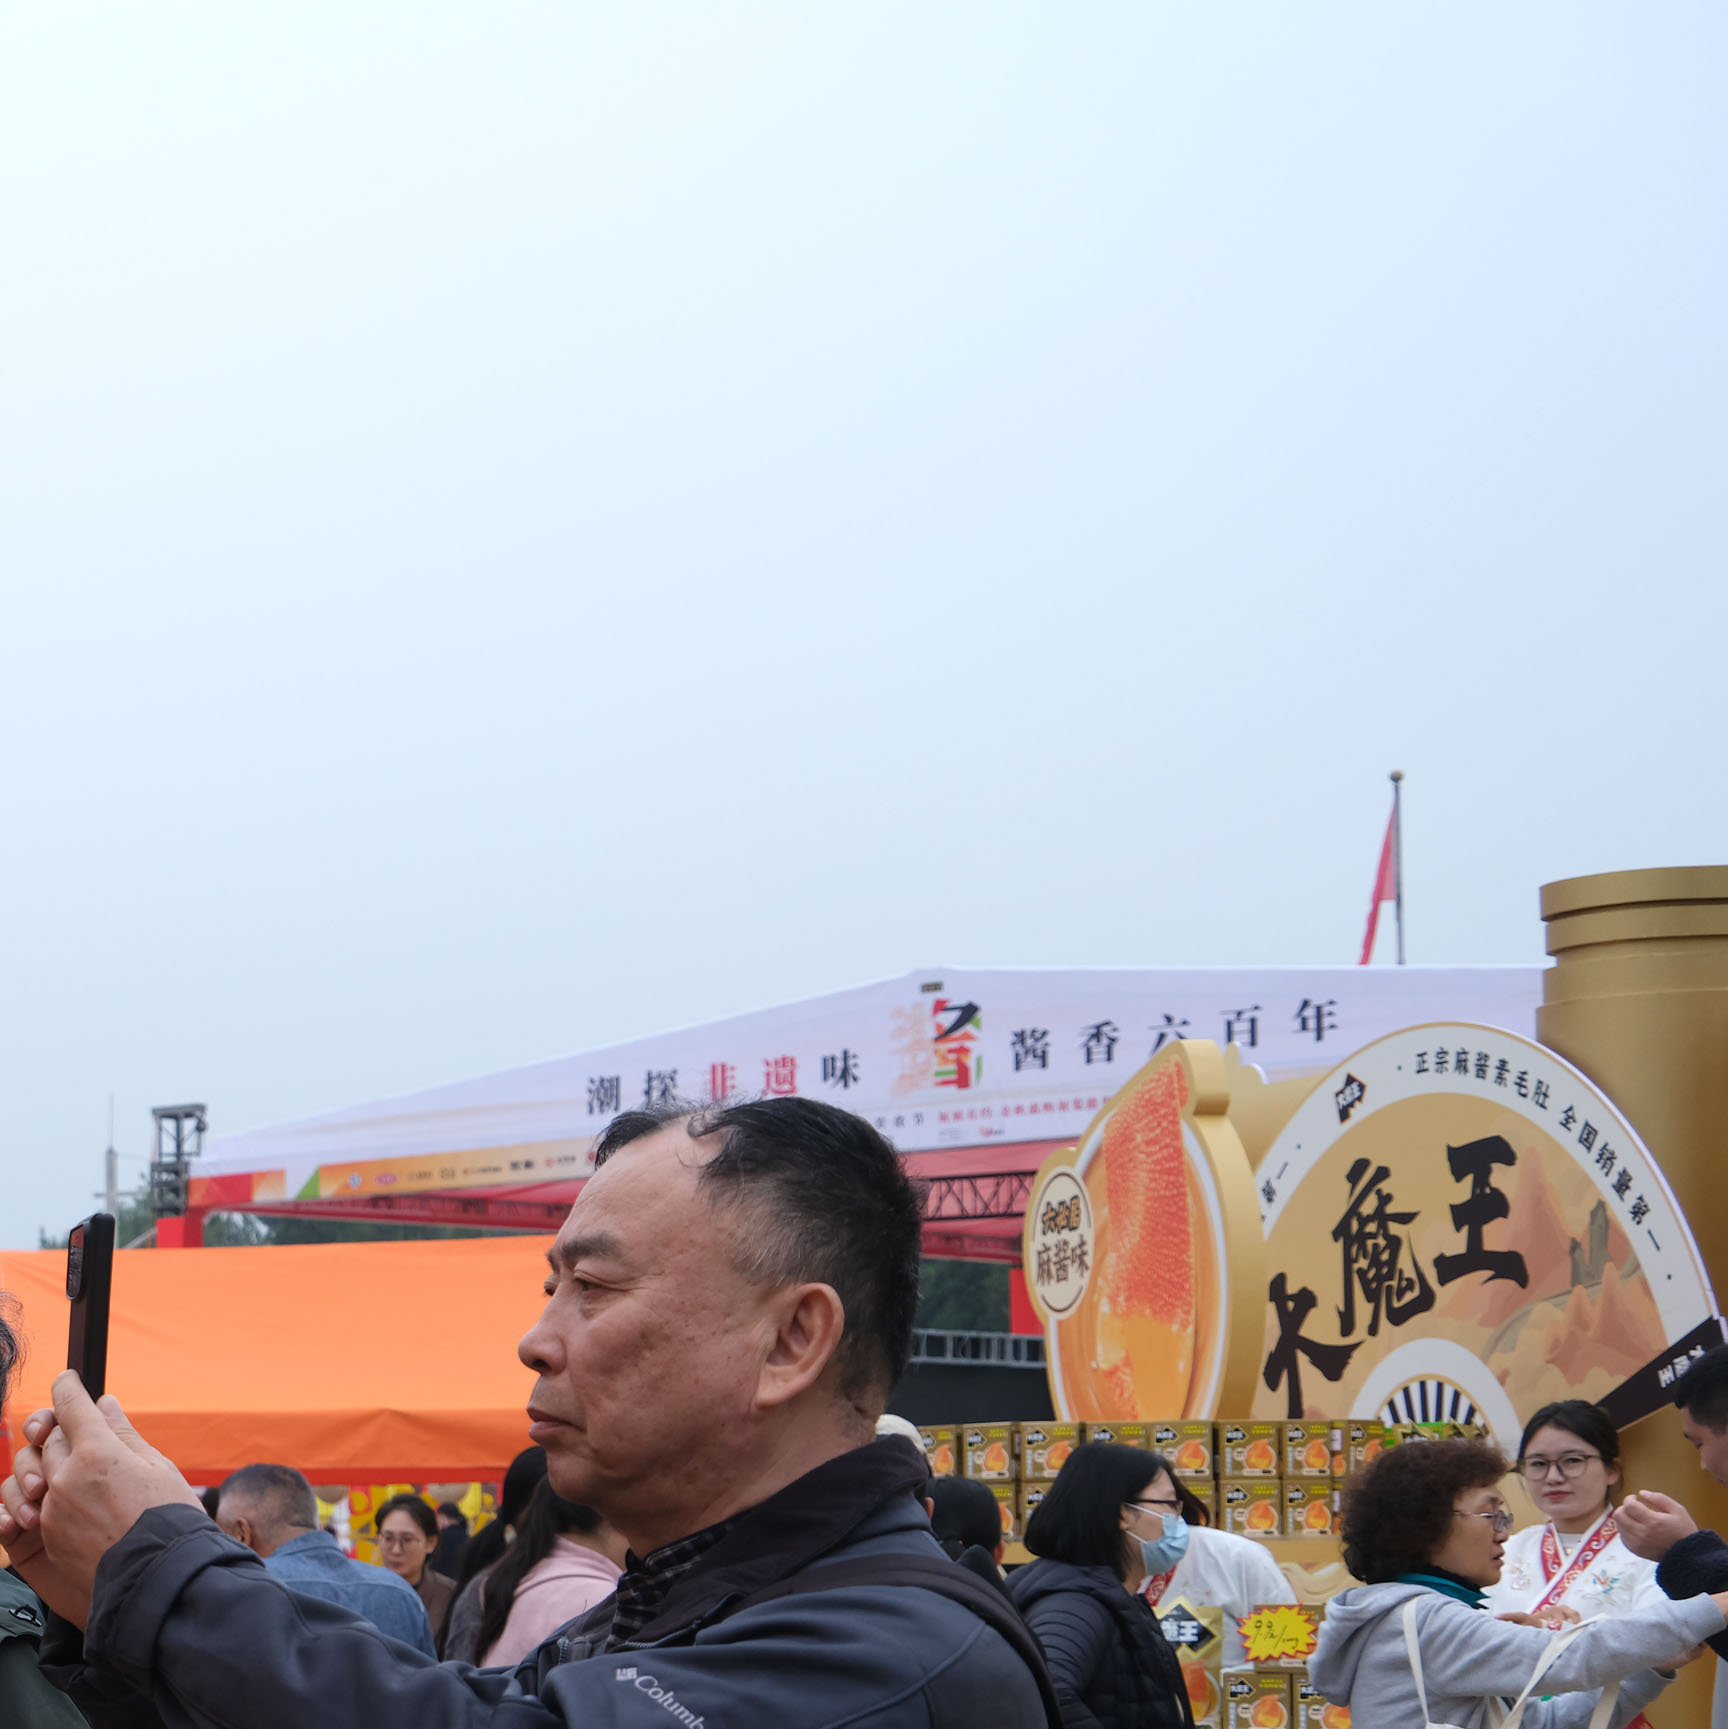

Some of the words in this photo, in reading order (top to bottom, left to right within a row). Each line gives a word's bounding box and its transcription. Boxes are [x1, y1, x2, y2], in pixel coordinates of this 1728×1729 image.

[1009, 998, 1341, 1072] 酱香六百年
[1415, 1047, 1551, 1110] 正宗麻酱素毛肚
[1559, 1105, 1661, 1252] 全国销量第一
[1036, 1233, 1090, 1287] 麻酱味
